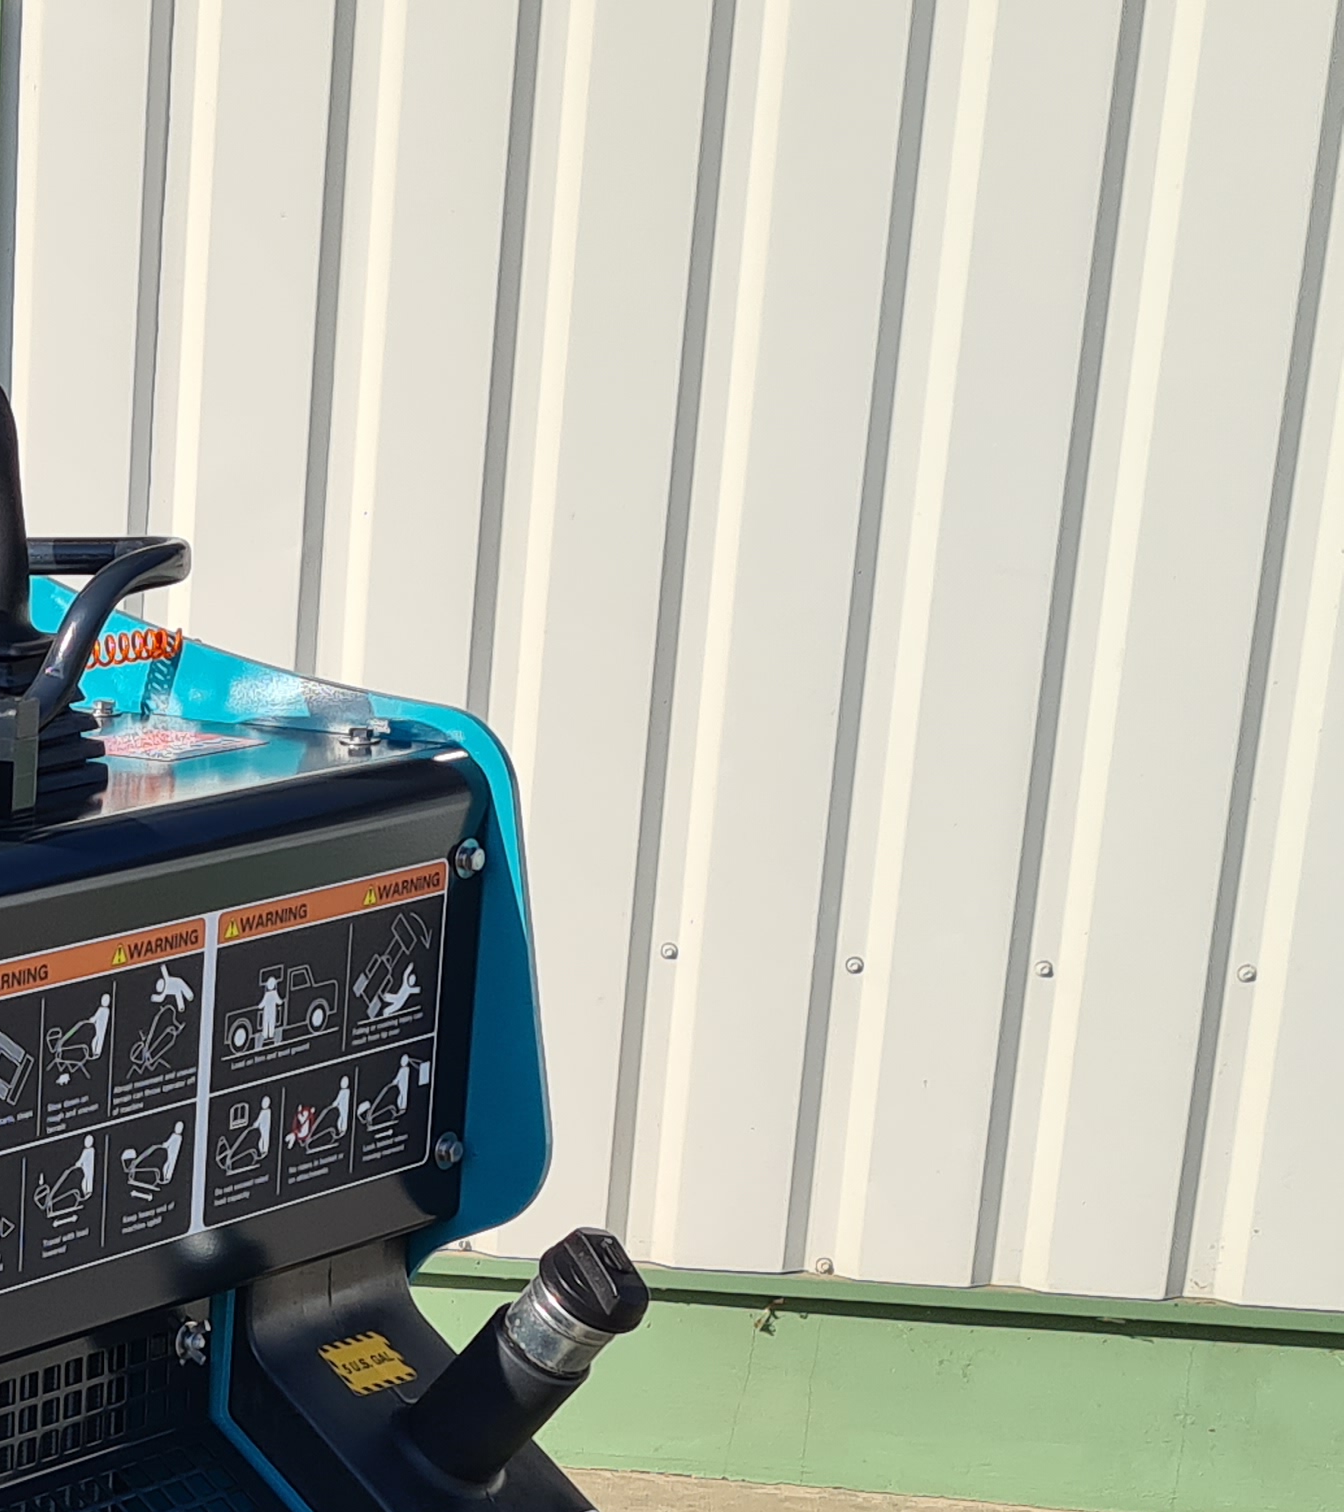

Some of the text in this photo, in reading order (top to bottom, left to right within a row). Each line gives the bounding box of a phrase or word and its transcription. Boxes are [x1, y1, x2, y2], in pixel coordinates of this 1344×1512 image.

[378, 871, 440, 901] WARNING
[240, 903, 308, 933] WARNING
[127, 928, 199, 960] WARNING
